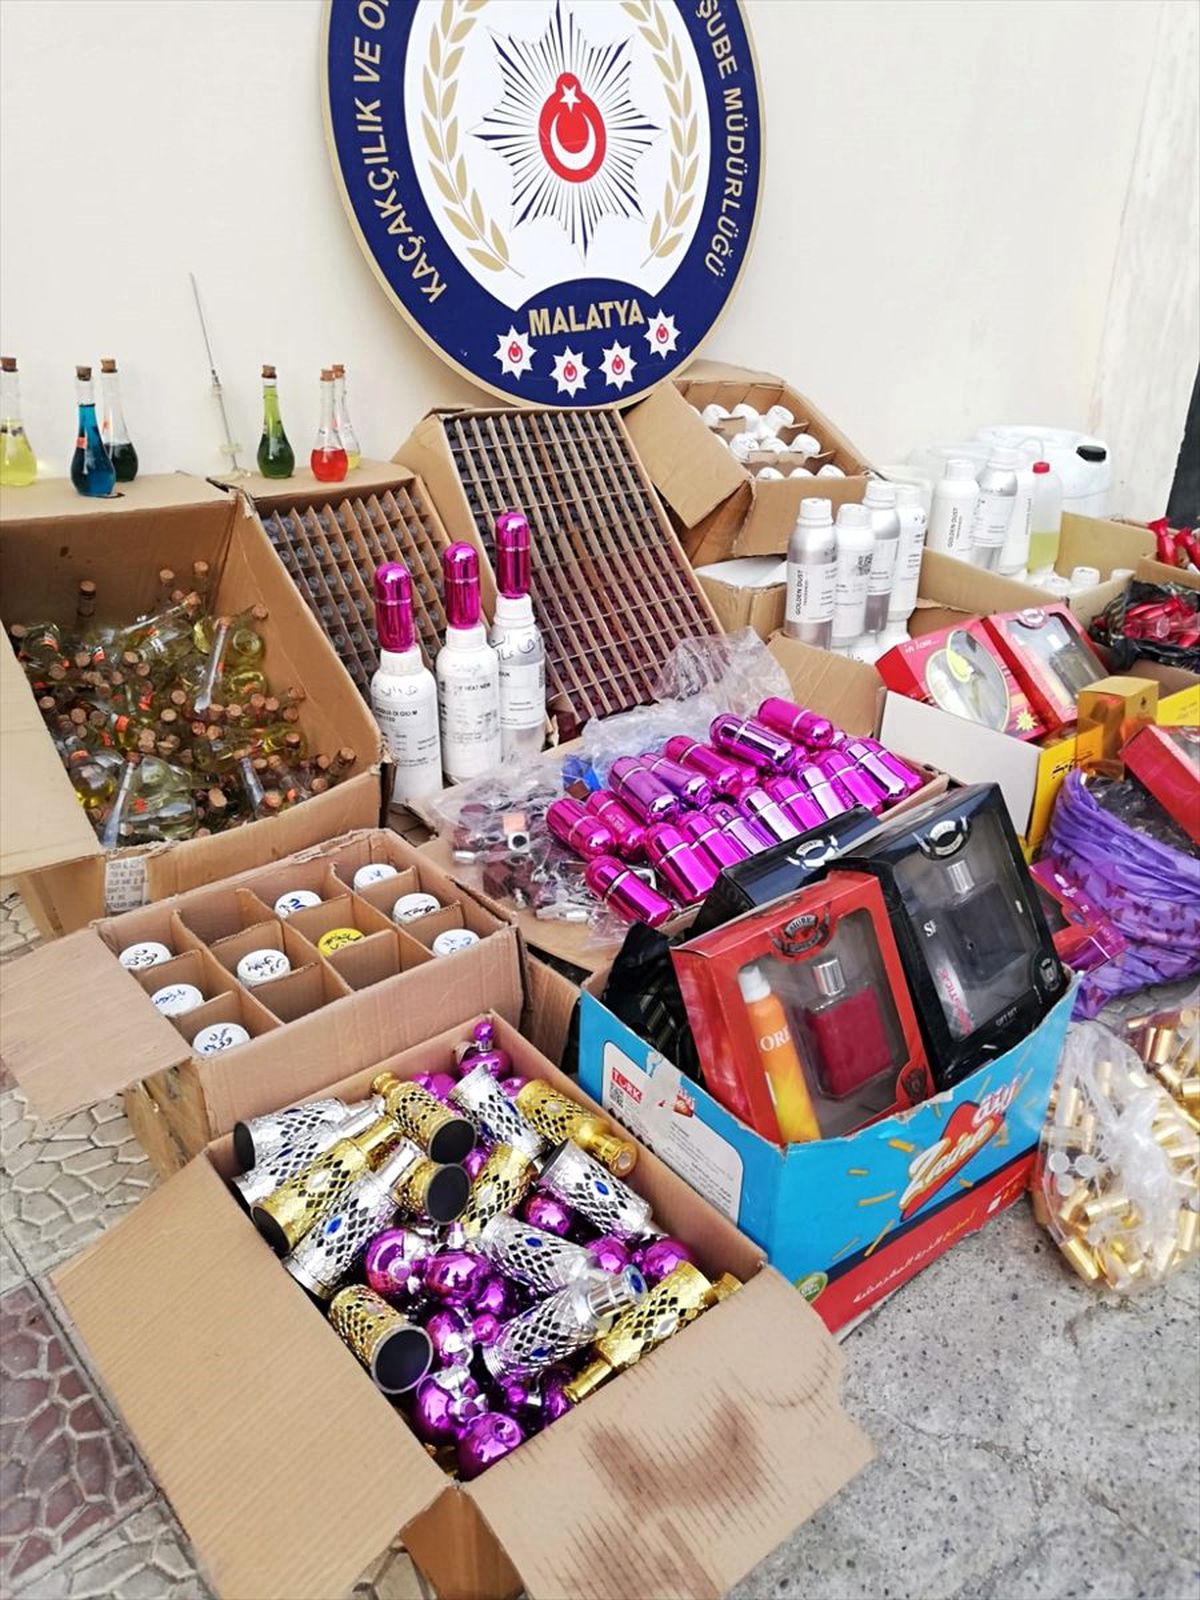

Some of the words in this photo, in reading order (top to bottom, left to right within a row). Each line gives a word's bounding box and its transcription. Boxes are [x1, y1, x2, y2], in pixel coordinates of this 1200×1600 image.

[357, 0, 390, 30] O
[353, 37, 382, 85] VE
[695, 0, 738, 80] ŞUBE
[355, 97, 448, 303] KAÇAKÇILIK
[705, 86, 748, 278] MÜDÜRLÜĞÜ
[528, 299, 646, 338] MALATYA
[795, 588, 803, 616] GOLDEN
